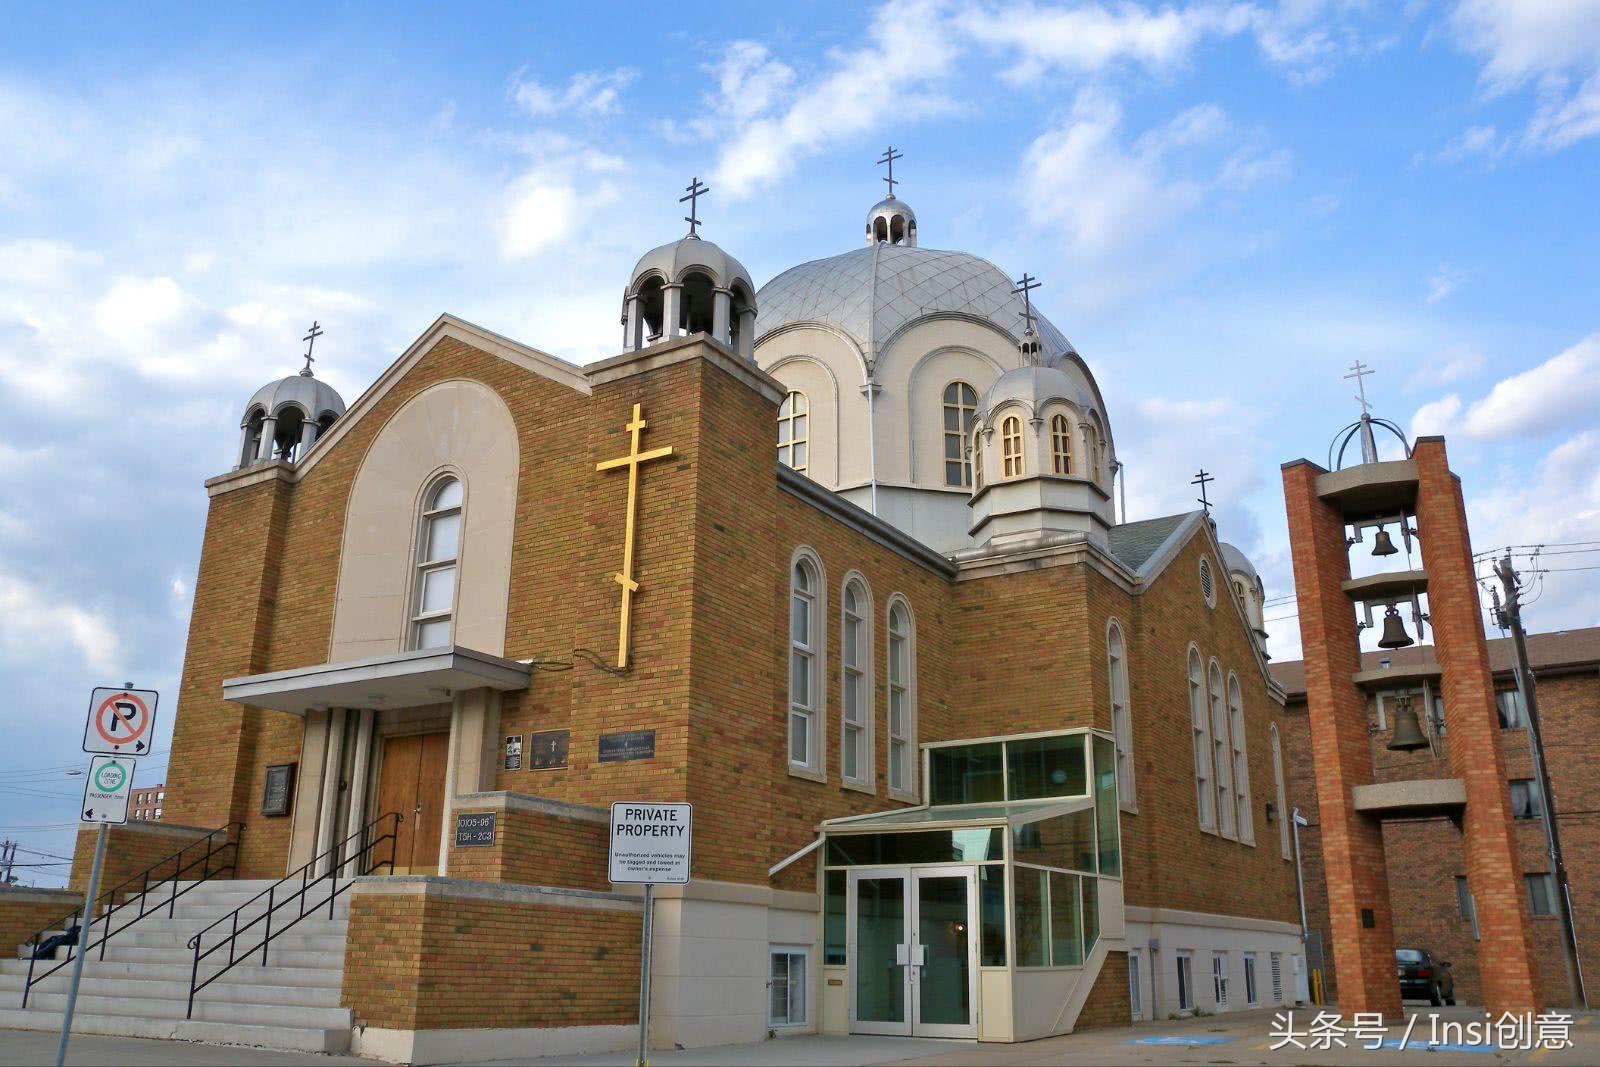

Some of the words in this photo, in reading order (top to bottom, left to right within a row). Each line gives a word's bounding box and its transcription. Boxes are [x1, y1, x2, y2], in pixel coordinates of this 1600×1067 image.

[110, 702, 136, 731] P
[625, 808, 678, 821] PRIVATE
[616, 823, 685, 837] PROPERTY
